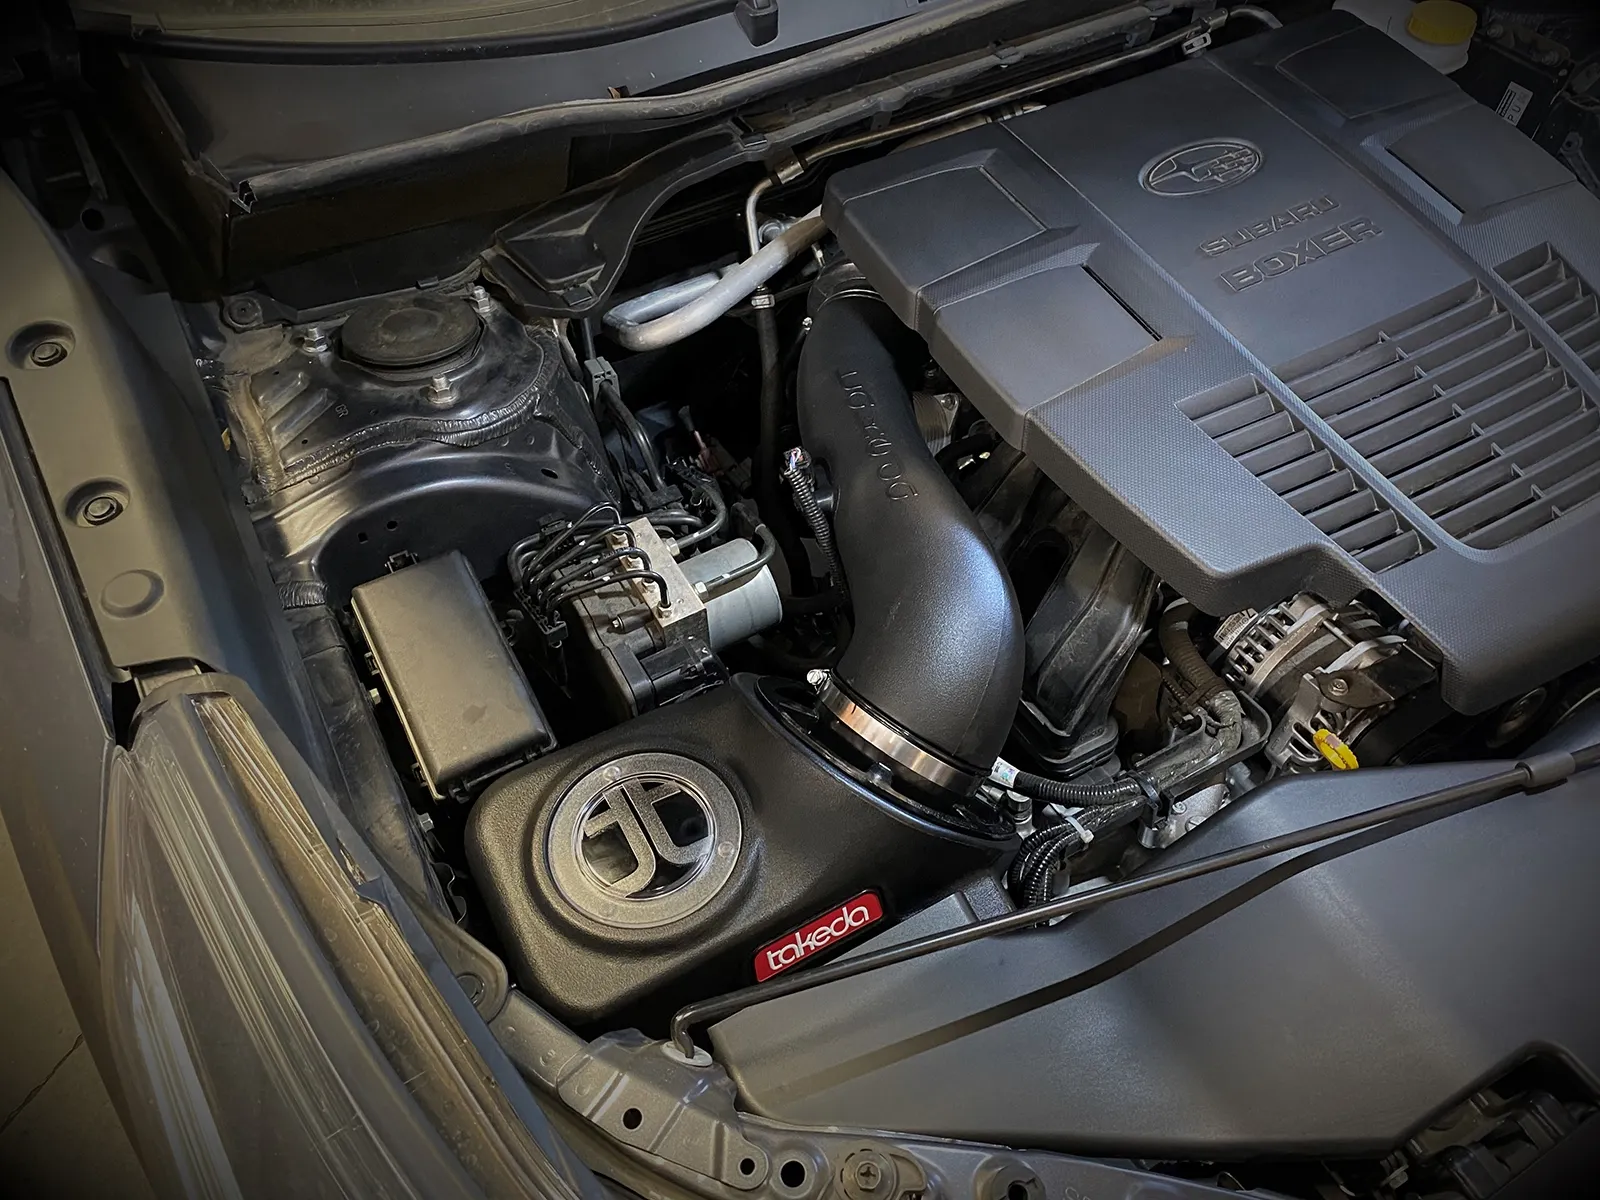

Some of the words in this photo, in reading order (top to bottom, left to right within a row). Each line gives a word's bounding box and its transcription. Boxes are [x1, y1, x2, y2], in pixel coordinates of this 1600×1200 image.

[1199, 195, 1340, 257] SUBARU
[1219, 217, 1384, 292] BOXER
[766, 904, 870, 971] takeda
